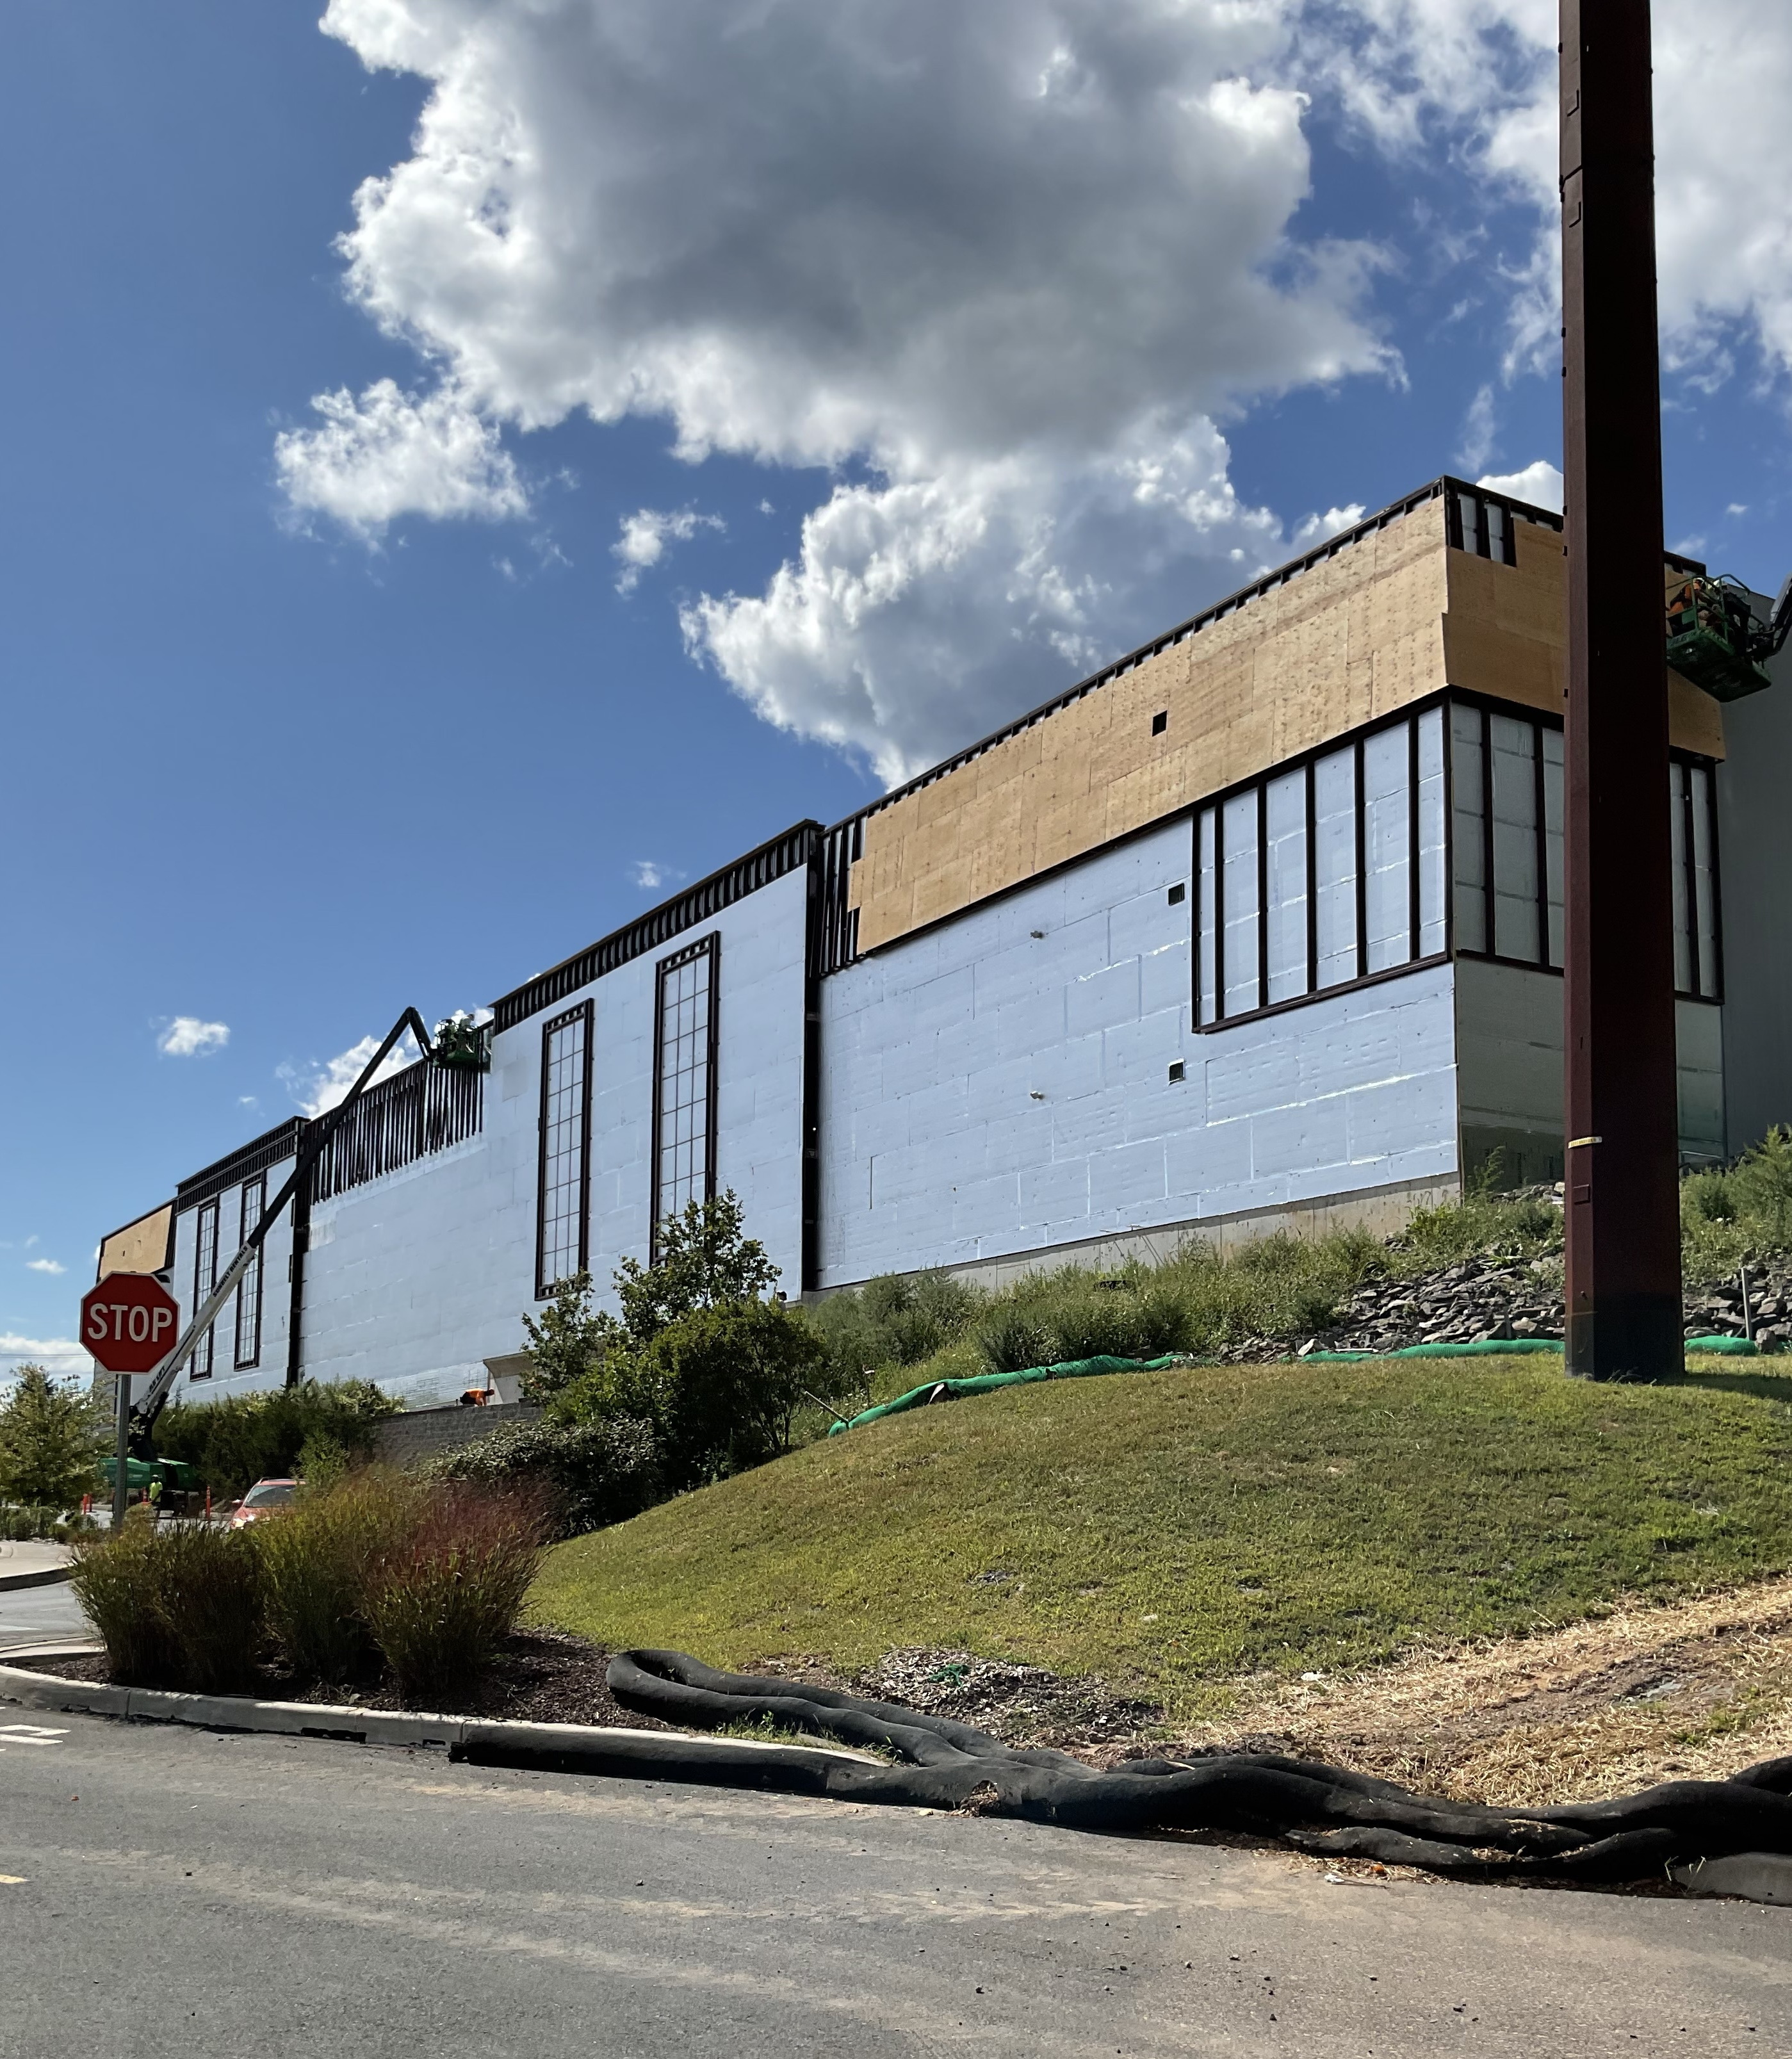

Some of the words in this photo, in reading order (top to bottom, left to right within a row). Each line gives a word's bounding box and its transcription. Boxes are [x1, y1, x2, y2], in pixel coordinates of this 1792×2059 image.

[213, 1271, 231, 1298] SUNBELT
[230, 1246, 248, 1273] RENTALS
[87, 1303, 173, 1342] STOP
